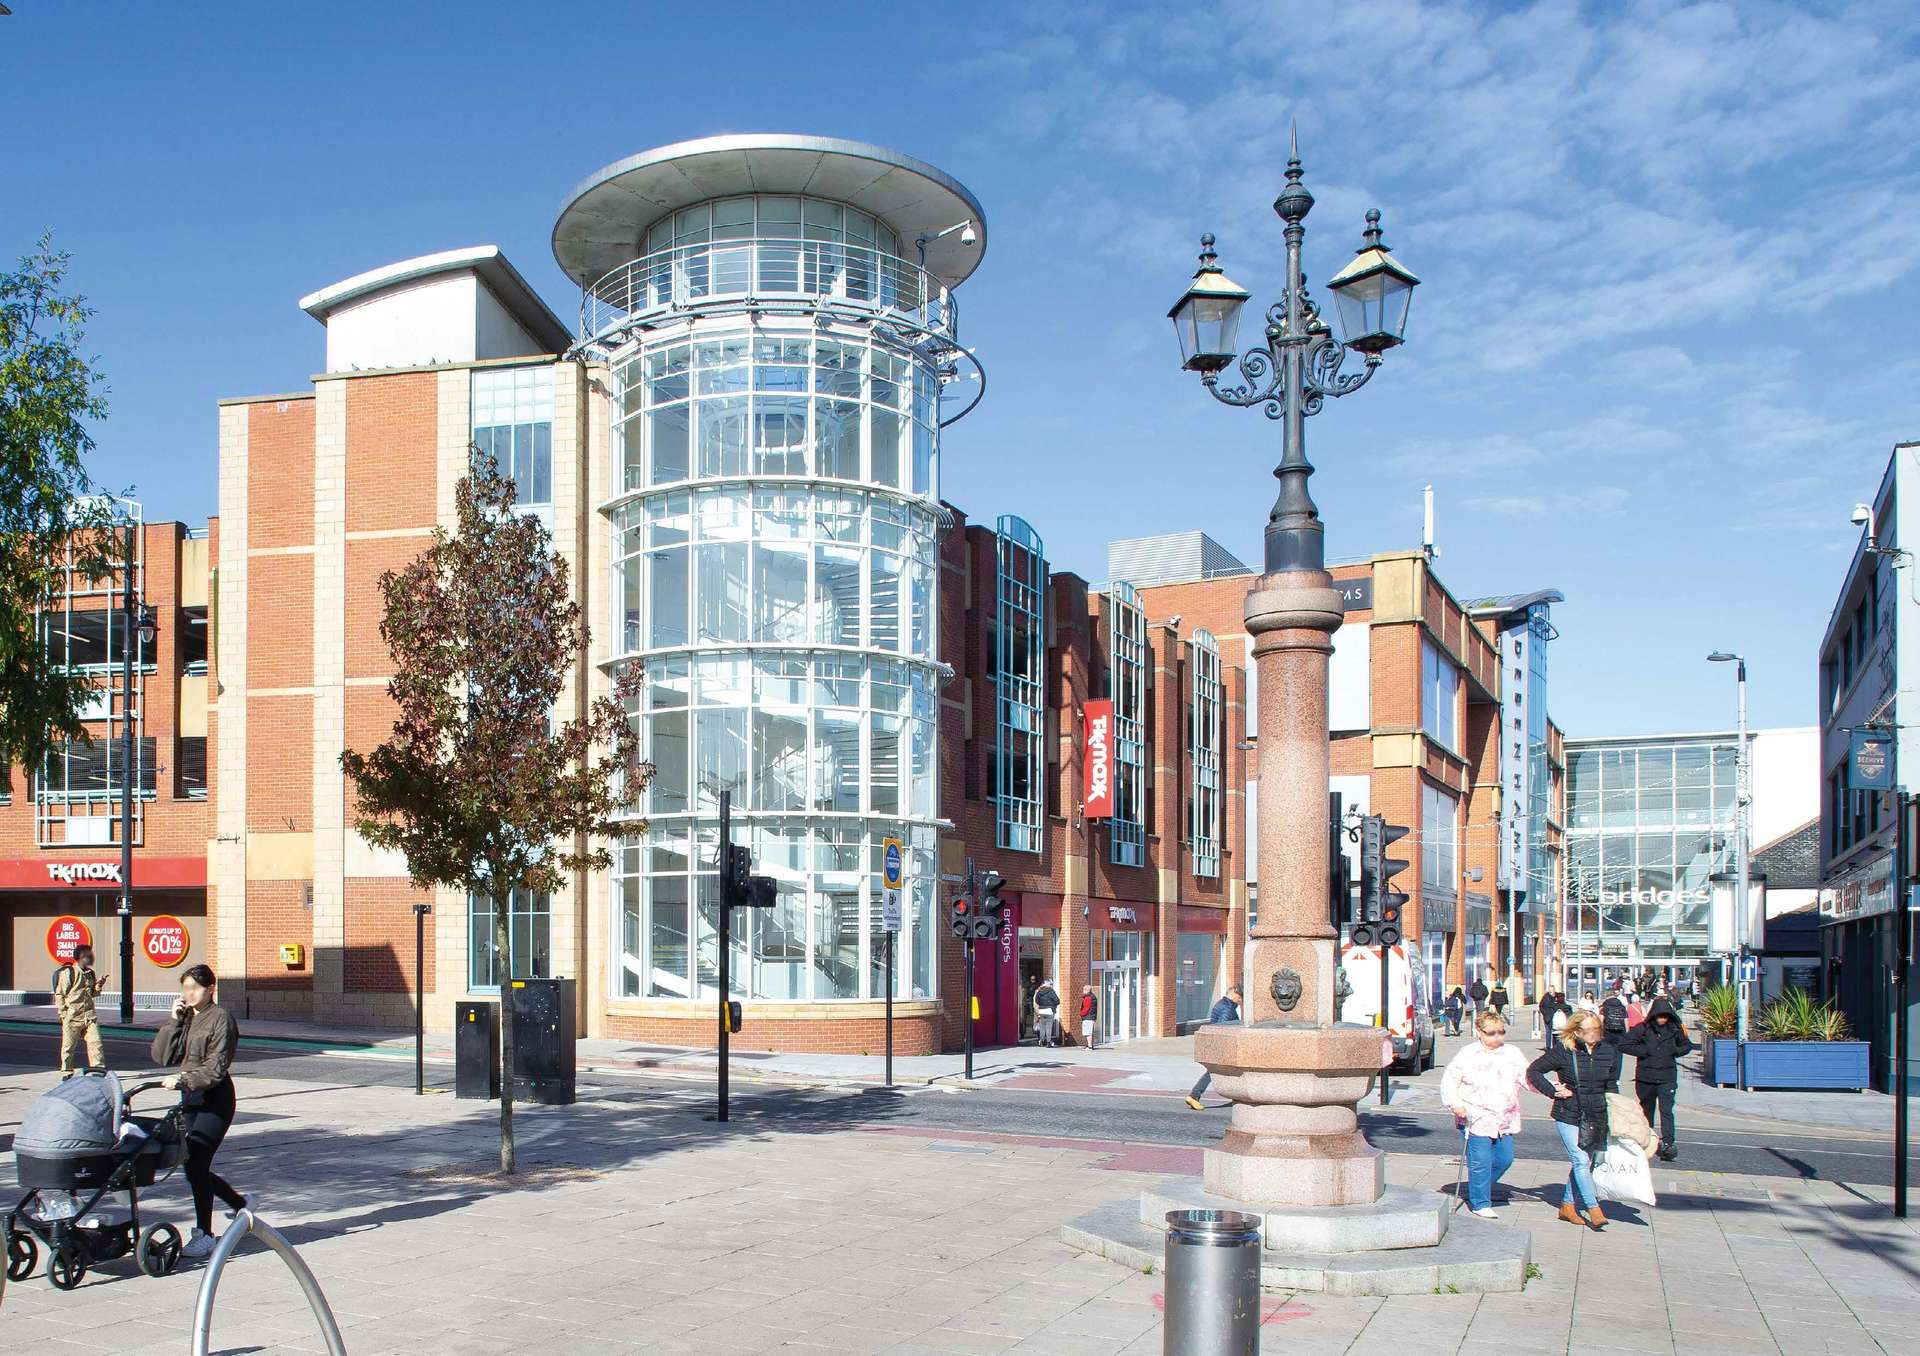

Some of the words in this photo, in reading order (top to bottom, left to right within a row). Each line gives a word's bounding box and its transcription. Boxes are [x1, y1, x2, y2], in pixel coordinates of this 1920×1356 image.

[1600, 886, 1711, 910] Bridges
[62, 923, 74, 931] BIG
[56, 931, 80, 940] LABELS
[1003, 908, 1011, 963] Bridges
